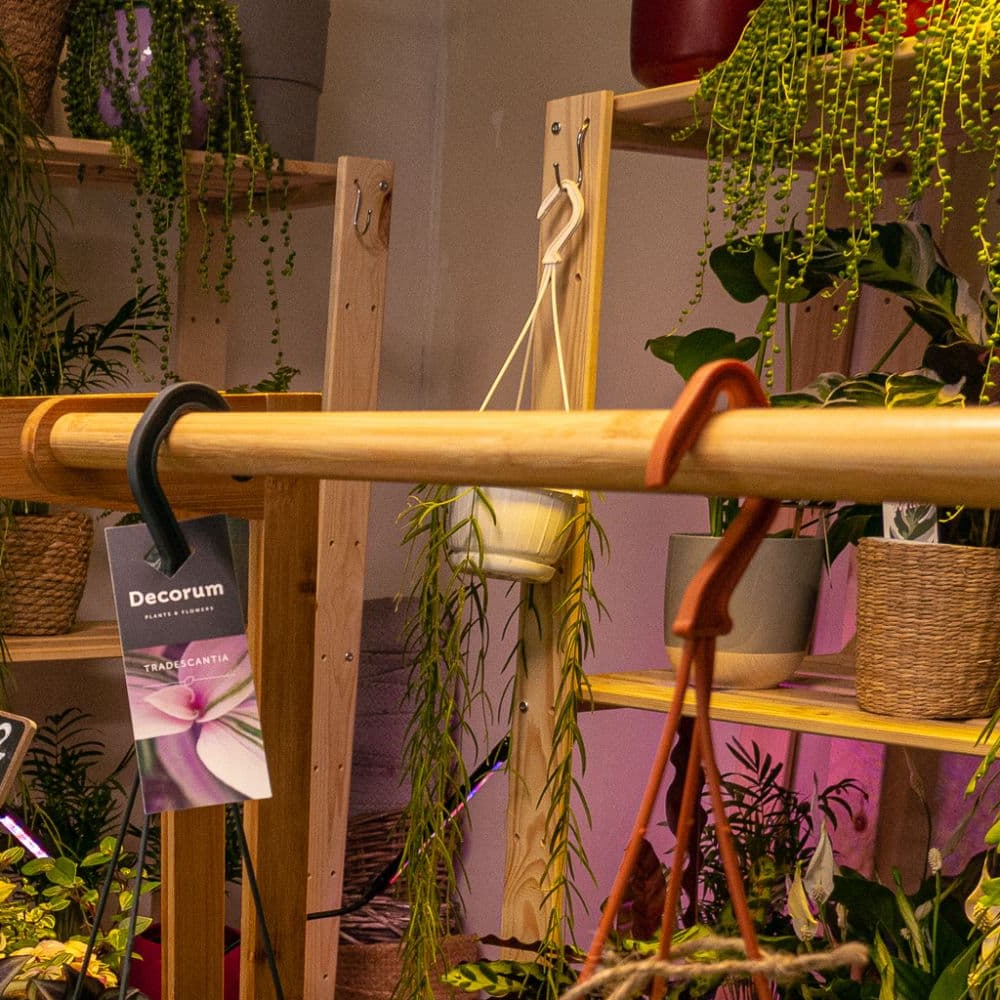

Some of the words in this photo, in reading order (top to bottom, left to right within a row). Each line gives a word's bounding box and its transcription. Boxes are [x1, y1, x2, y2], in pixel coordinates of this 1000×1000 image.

[128, 583, 225, 608] Decorum
[144, 611, 172, 621] PLANTS
[181, 605, 214, 615] FLOWERS
[144, 653, 229, 673] TRADESCANTIA
